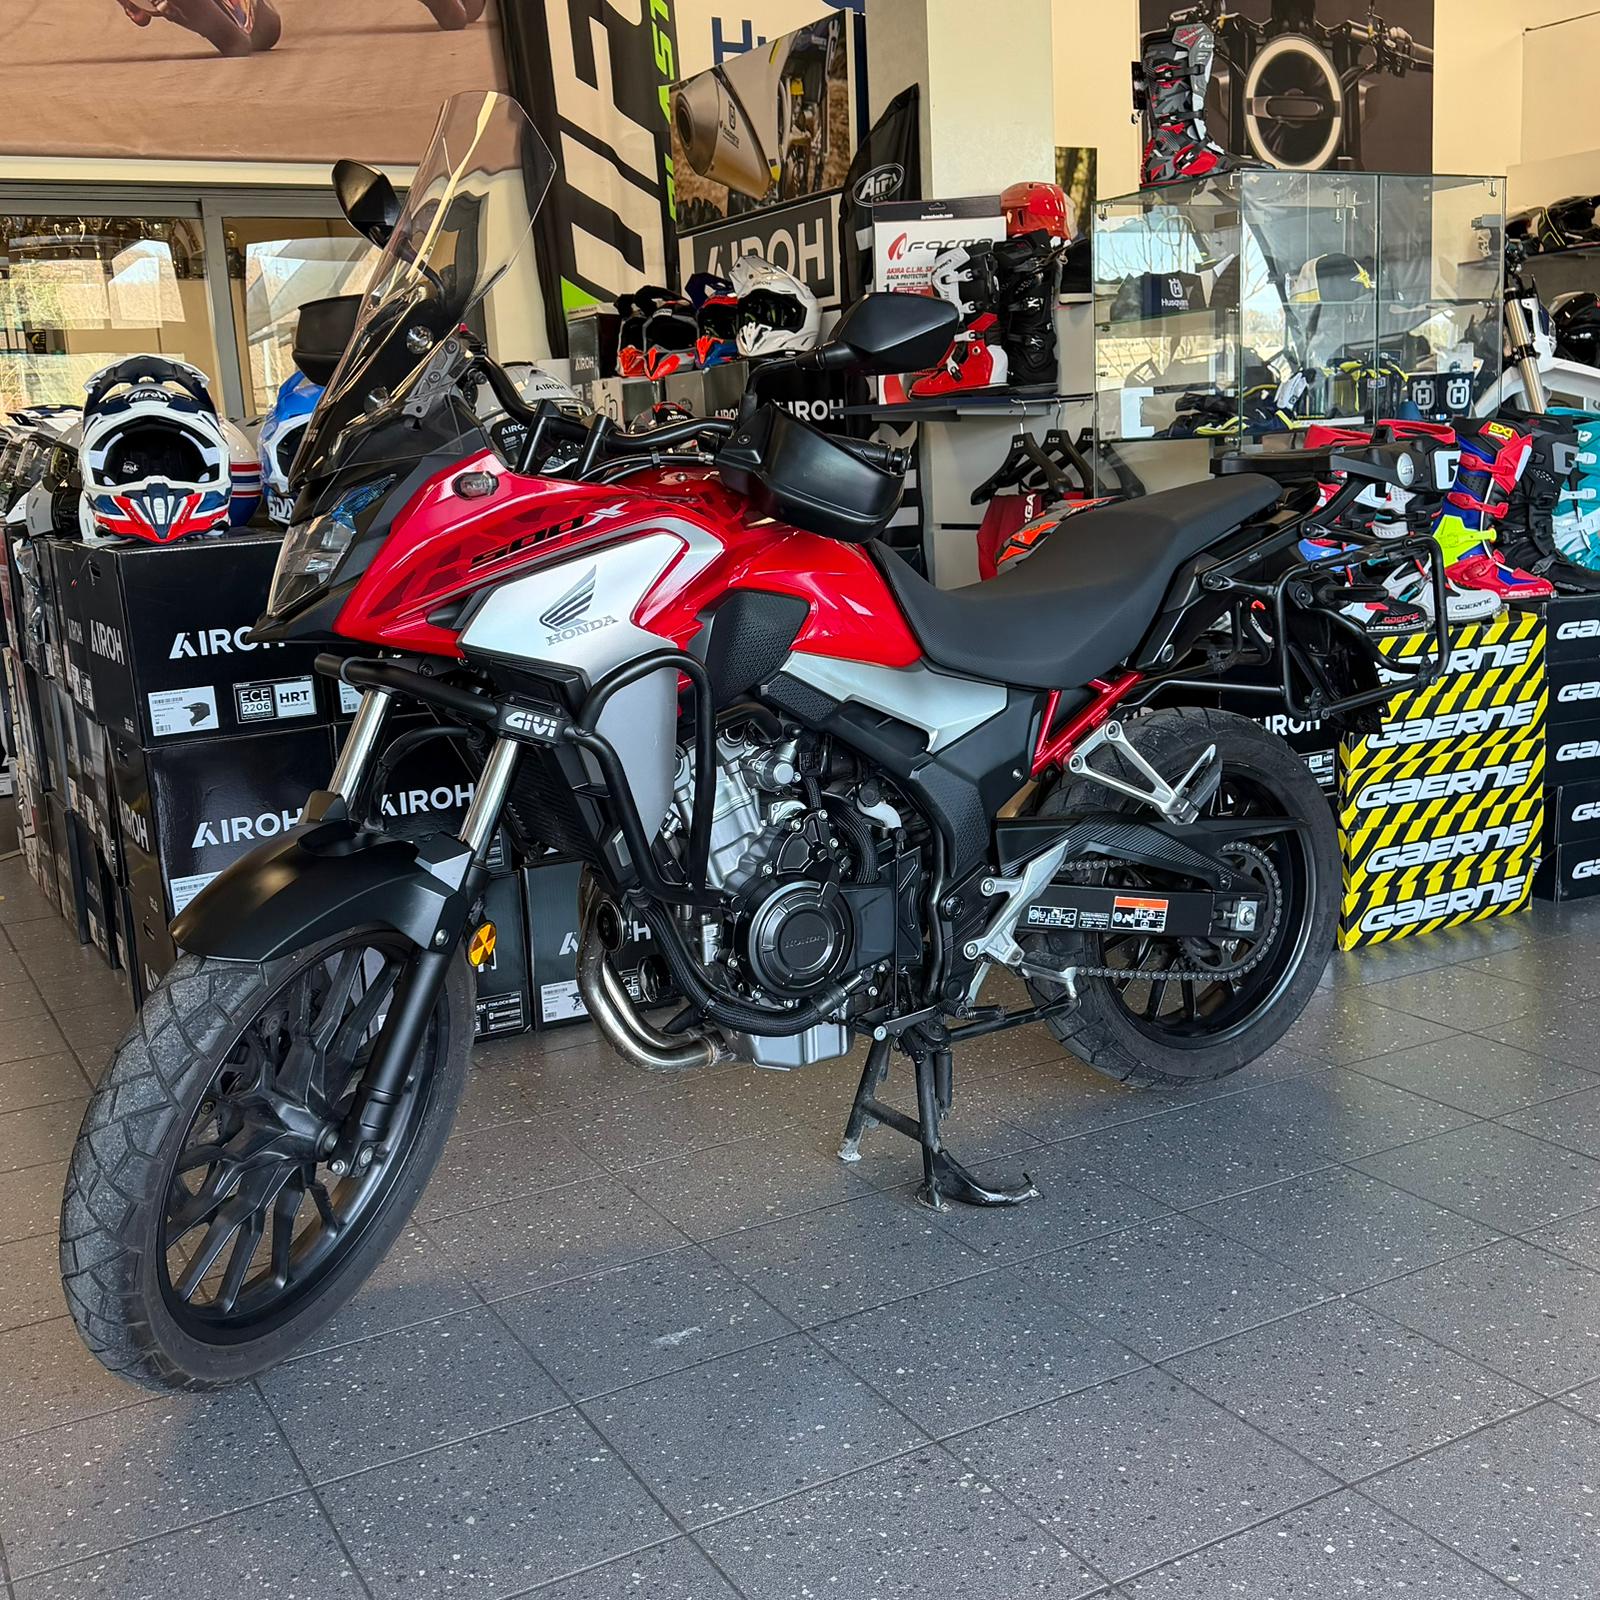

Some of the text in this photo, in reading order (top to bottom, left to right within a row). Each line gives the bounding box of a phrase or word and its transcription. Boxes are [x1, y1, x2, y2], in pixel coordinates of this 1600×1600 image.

[545, 0, 666, 299] UF
[535, 383, 567, 392] AIROH
[772, 399, 846, 422] IROH
[501, 423, 529, 435] AIRO
[1047, 436, 1060, 444] LS2
[1013, 440, 1025, 449] LS2
[90, 619, 126, 666] AIROH
[168, 626, 287, 660] AIRO
[545, 614, 620, 647] HONDA
[240, 689, 271, 703] ECE
[243, 702, 271, 713] 2206
[279, 690, 310, 704] HRT
[505, 711, 558, 738] GIVI
[380, 782, 476, 817] AIROH
[1356, 760, 1533, 809] GAERNE
[191, 807, 304, 849] AIROH
[1365, 820, 1533, 874] GAERNE
[1360, 875, 1526, 933] GAERNE
